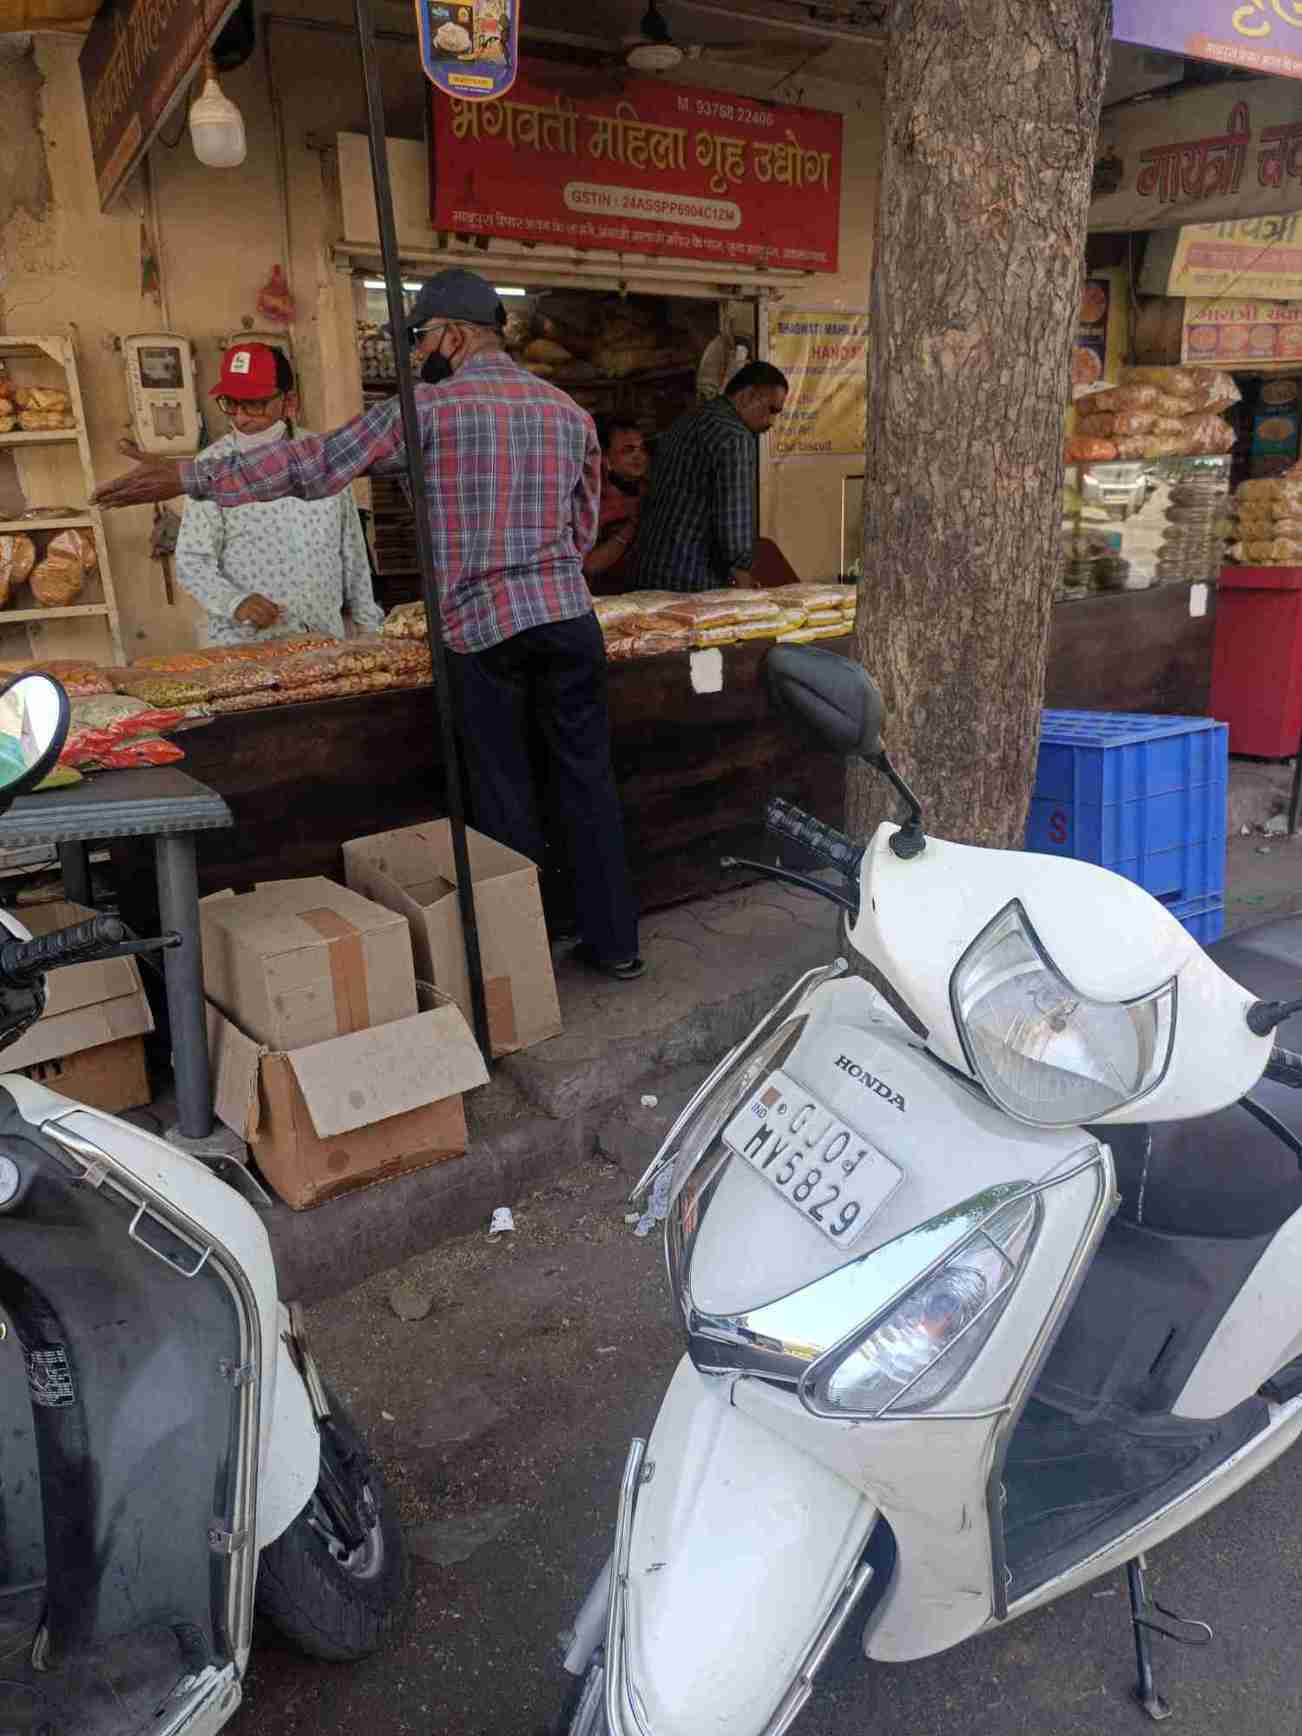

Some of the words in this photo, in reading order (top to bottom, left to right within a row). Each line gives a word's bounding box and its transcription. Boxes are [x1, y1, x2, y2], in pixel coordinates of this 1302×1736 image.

[590, 101, 689, 171] महिला
[696, 130, 745, 193] गृह
[571, 190, 611, 208] GSTIN
[750, 1101, 768, 1119] IND
[833, 1053, 907, 1113] HONDA
[742, 1122, 862, 1237] MY5829
